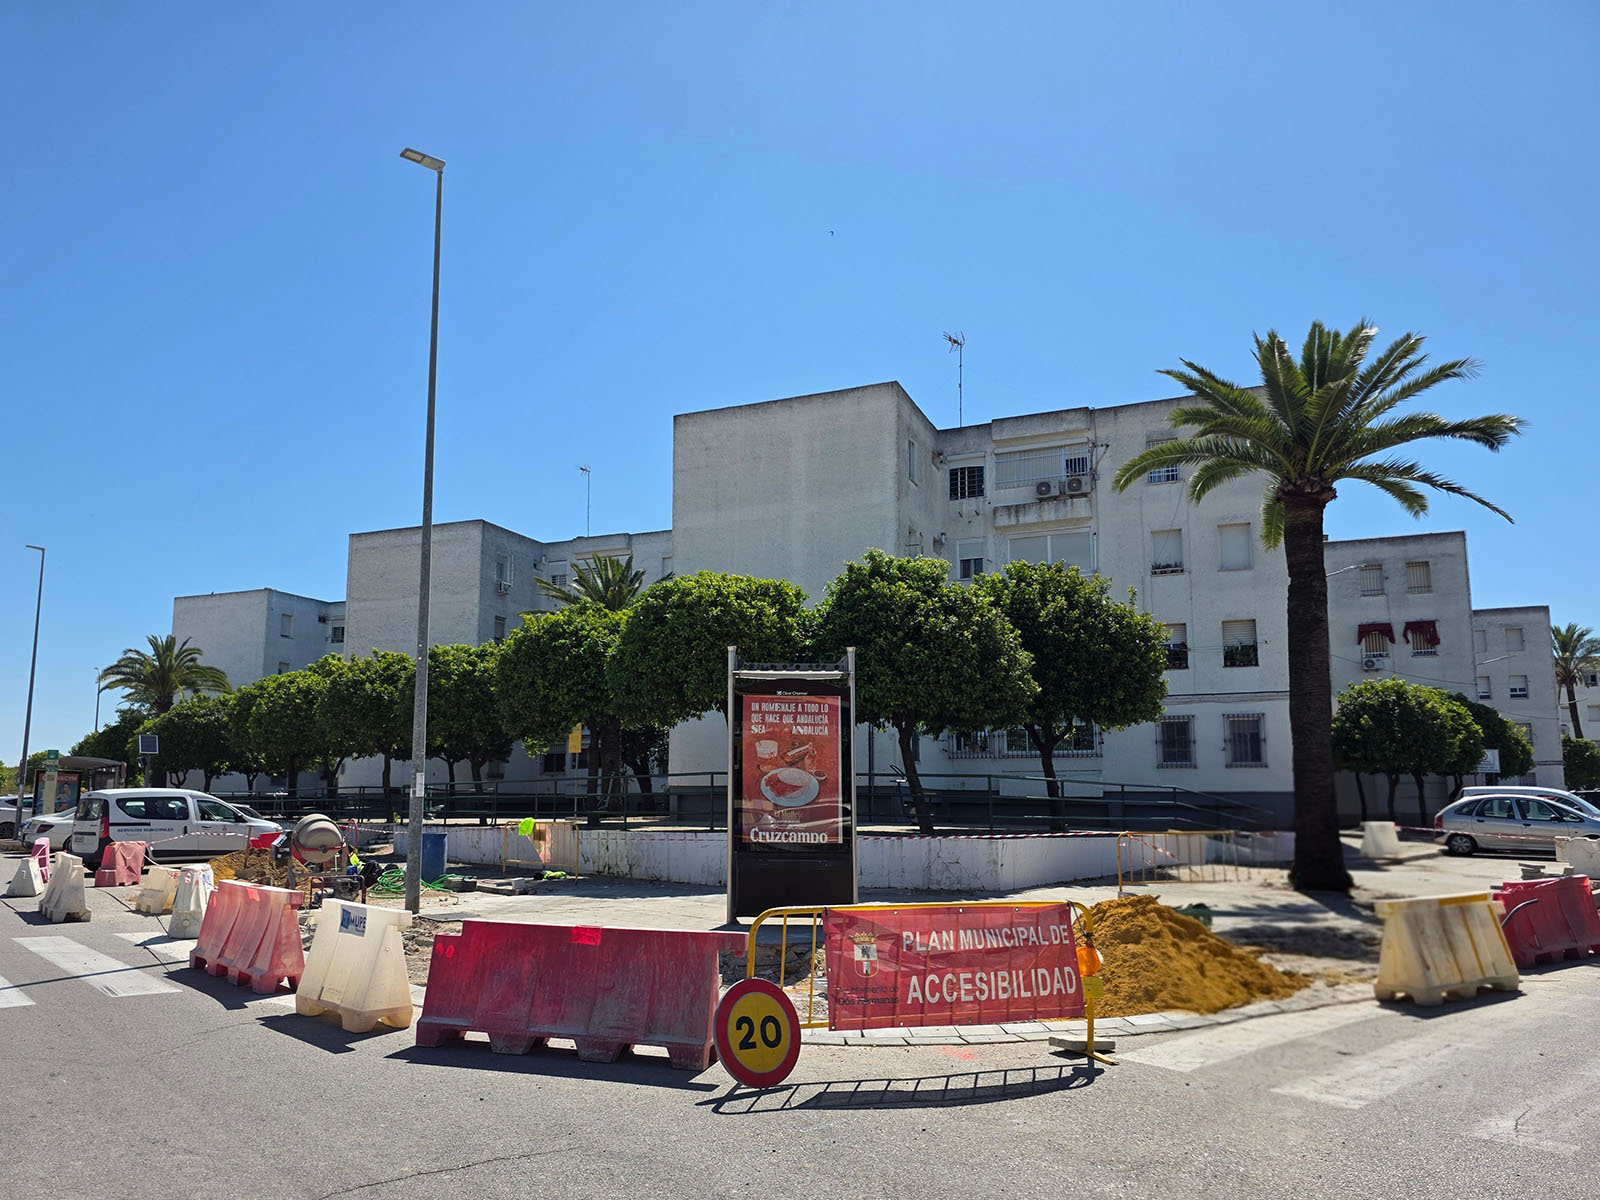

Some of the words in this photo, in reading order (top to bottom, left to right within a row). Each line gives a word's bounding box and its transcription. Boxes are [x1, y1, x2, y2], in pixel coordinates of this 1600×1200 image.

[751, 702, 760, 712] UN
[797, 703, 803, 713] A
[804, 703, 819, 713] TODO
[820, 704, 829, 714] LO
[751, 713, 763, 723] QUE
[764, 713, 780, 724] HACE
[782, 714, 794, 725] QUE
[796, 714, 829, 725] ANDALUCÍA
[751, 724, 766, 735] SEA
[749, 826, 828, 844] Cruzcampo
[902, 930, 954, 951] PLAN
[959, 925, 1049, 950] MUNICIPAL
[1050, 924, 1070, 945] DE
[906, 966, 1077, 1005] ACCESIBILIDAD
[736, 1015, 782, 1050] 20
